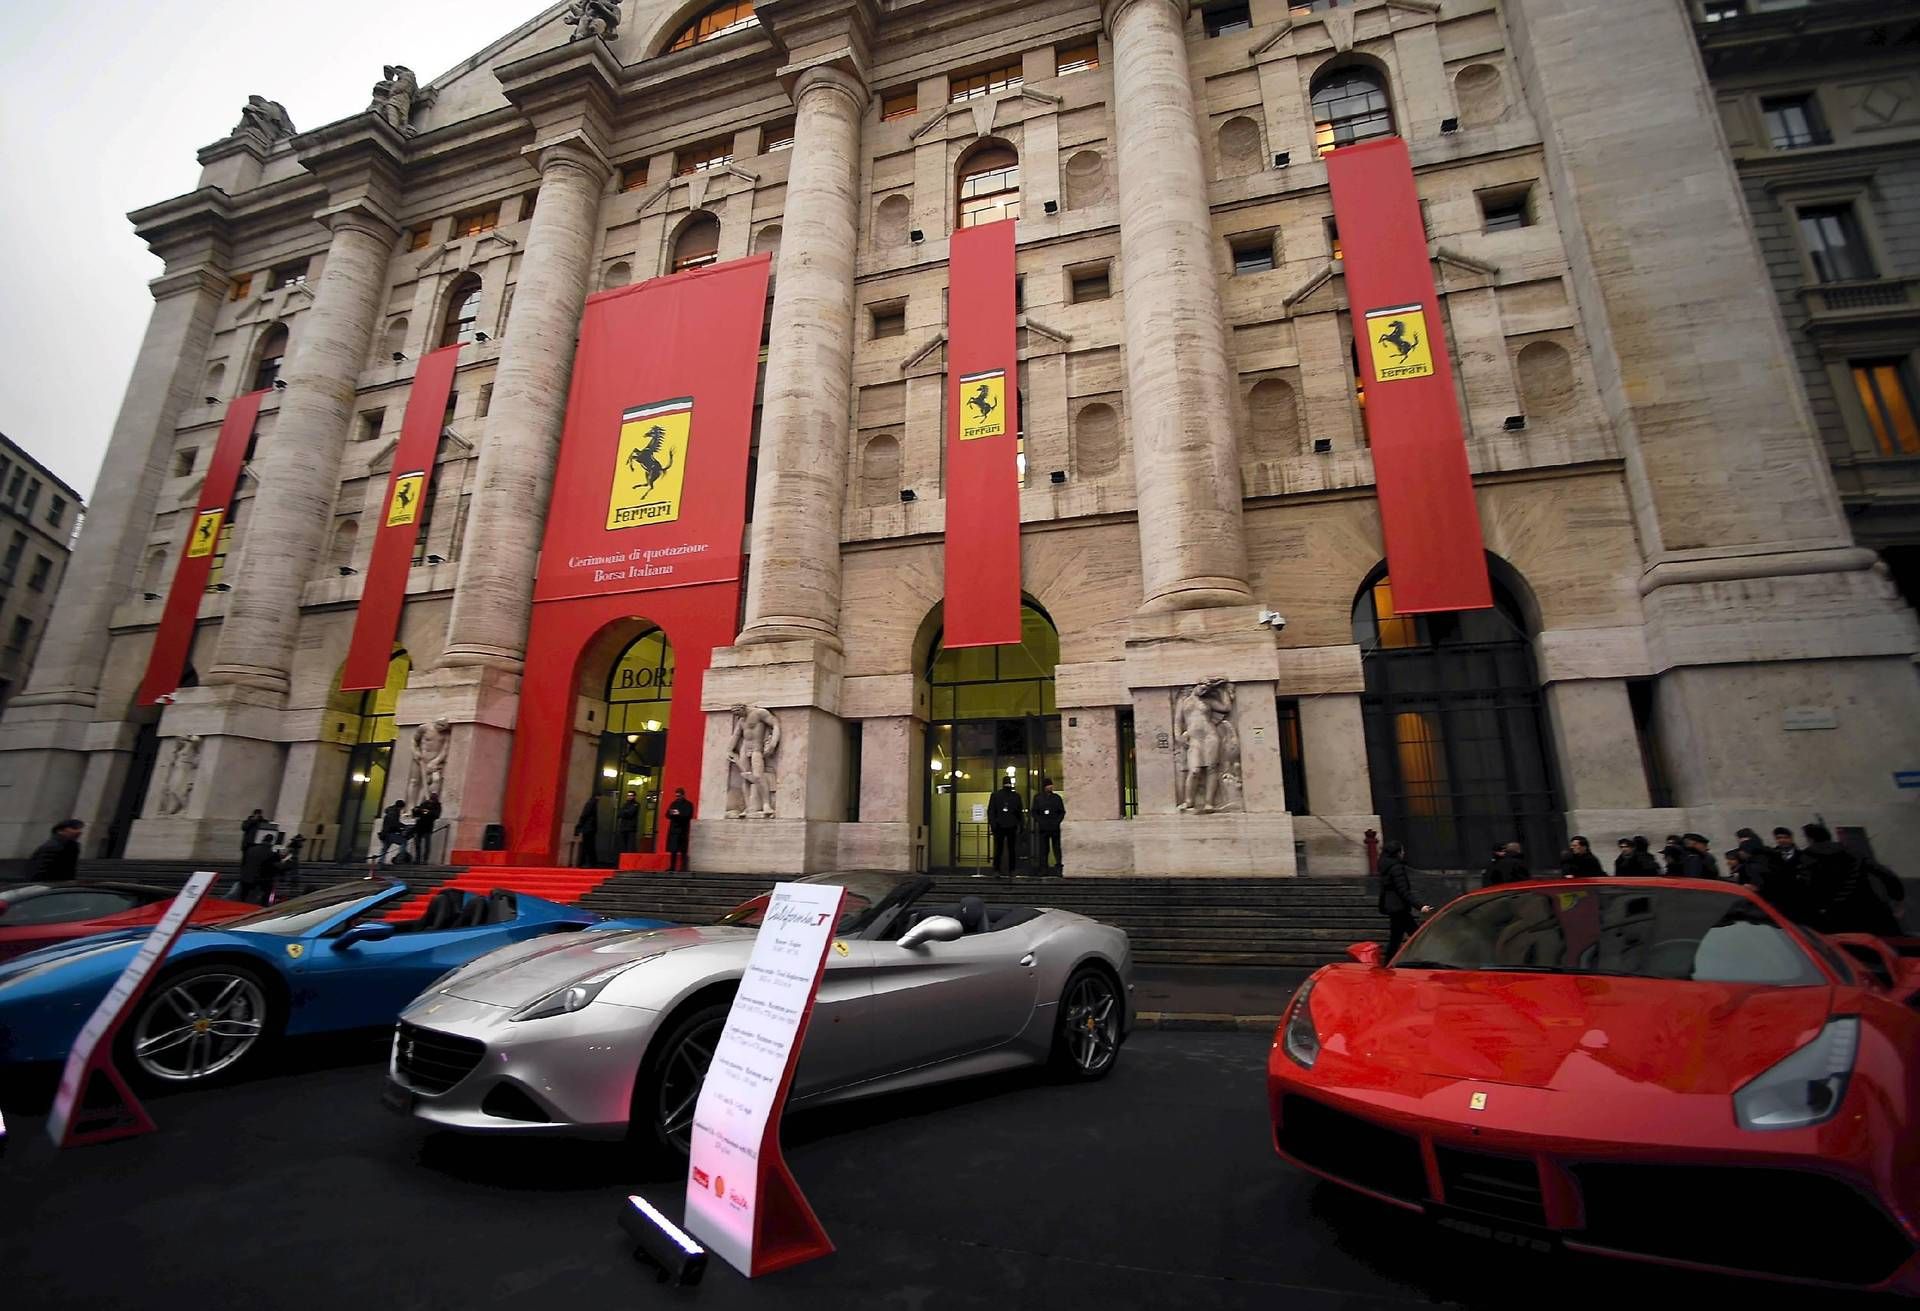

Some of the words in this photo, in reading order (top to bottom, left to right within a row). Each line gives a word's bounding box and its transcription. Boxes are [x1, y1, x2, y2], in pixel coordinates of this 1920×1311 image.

[1380, 363, 1427, 378] Ferrari
[964, 423, 1001, 436] Ferrari
[613, 500, 672, 523] Ferrari
[568, 551, 625, 568] Cerimonia
[628, 548, 641, 561] di
[643, 543, 709, 563] quotazione
[594, 569, 625, 582] Borsa
[628, 564, 673, 578] Italiana
